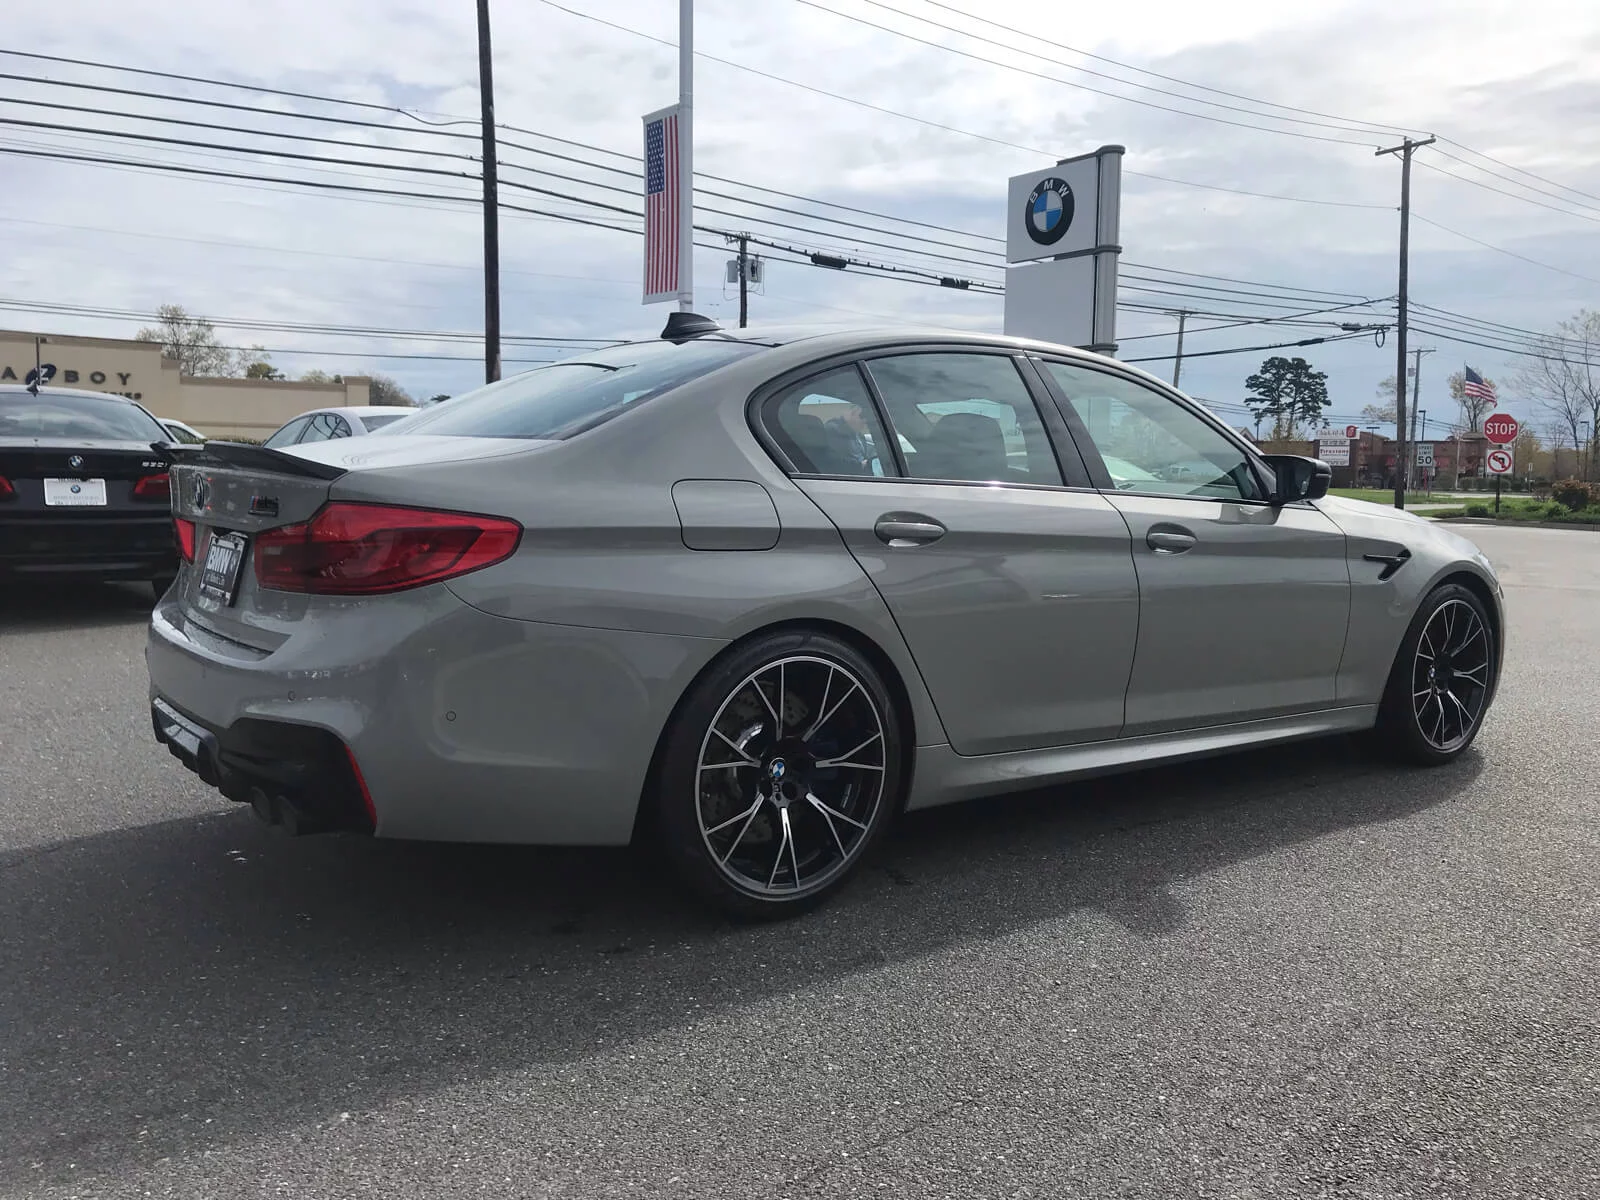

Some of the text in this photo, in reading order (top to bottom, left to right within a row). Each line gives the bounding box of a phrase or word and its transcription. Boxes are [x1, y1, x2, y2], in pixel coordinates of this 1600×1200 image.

[1029, 179, 1070, 204] BMW
[64, 370, 131, 385] BOY
[1486, 422, 1517, 435] STOP
[1418, 456, 1432, 465] 50
[207, 545, 232, 574] BMW
